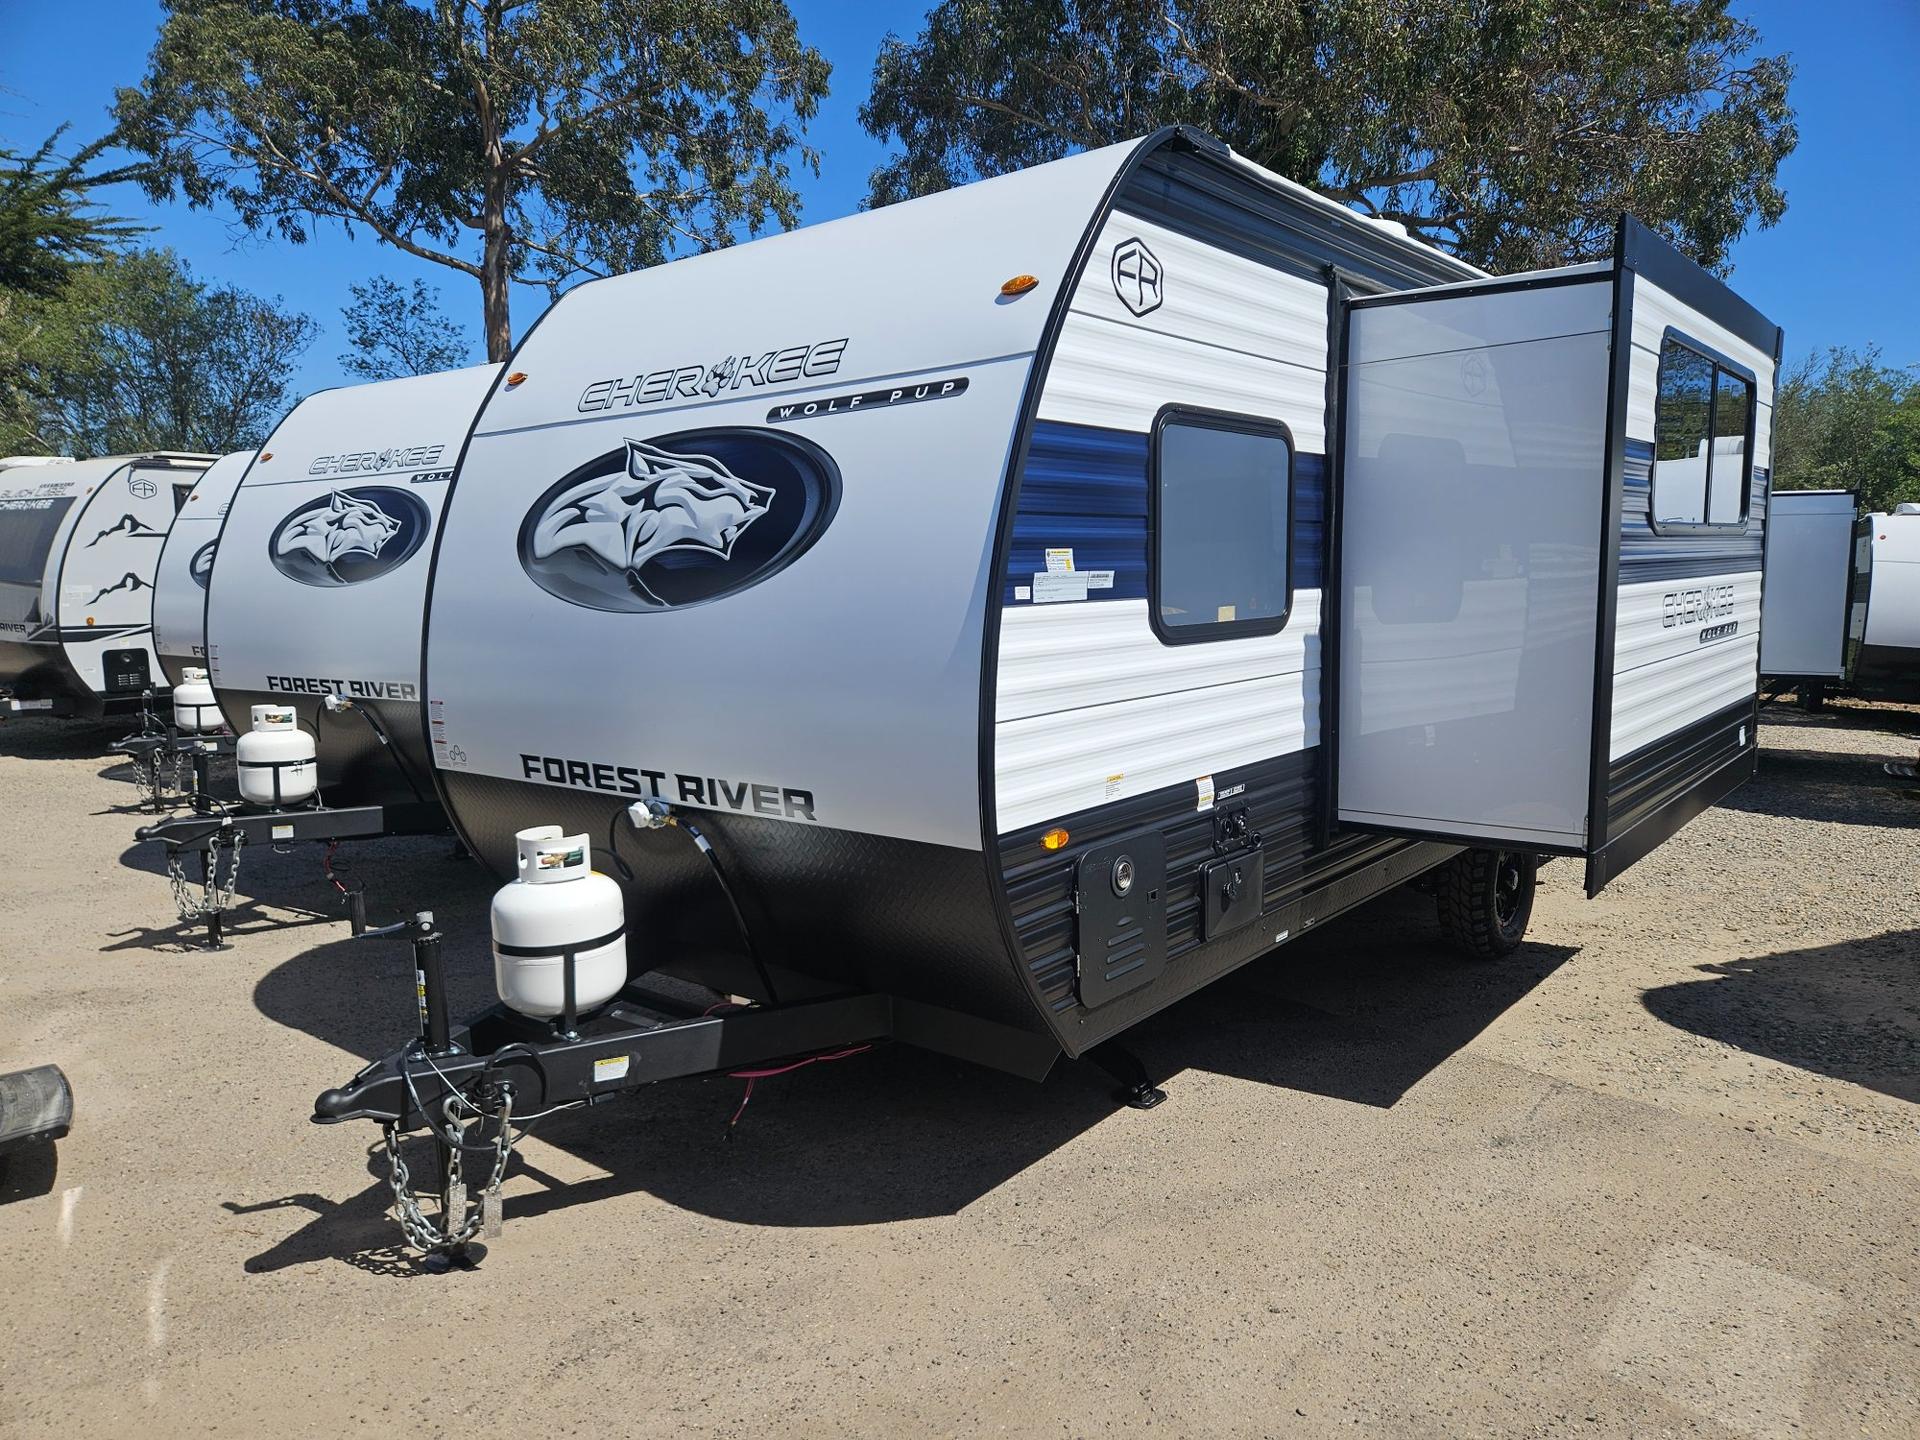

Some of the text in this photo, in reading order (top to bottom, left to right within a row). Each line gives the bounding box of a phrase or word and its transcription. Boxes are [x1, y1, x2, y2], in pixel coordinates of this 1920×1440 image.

[577, 338, 849, 412] CHEROKEE
[779, 381, 955, 419] WOLF PUP
[309, 445, 445, 474] CHEROKEE
[1663, 585, 1734, 628] CHEROKEE
[266, 675, 416, 700] FOREST RIVER
[519, 753, 818, 822] FOREST RIVER
